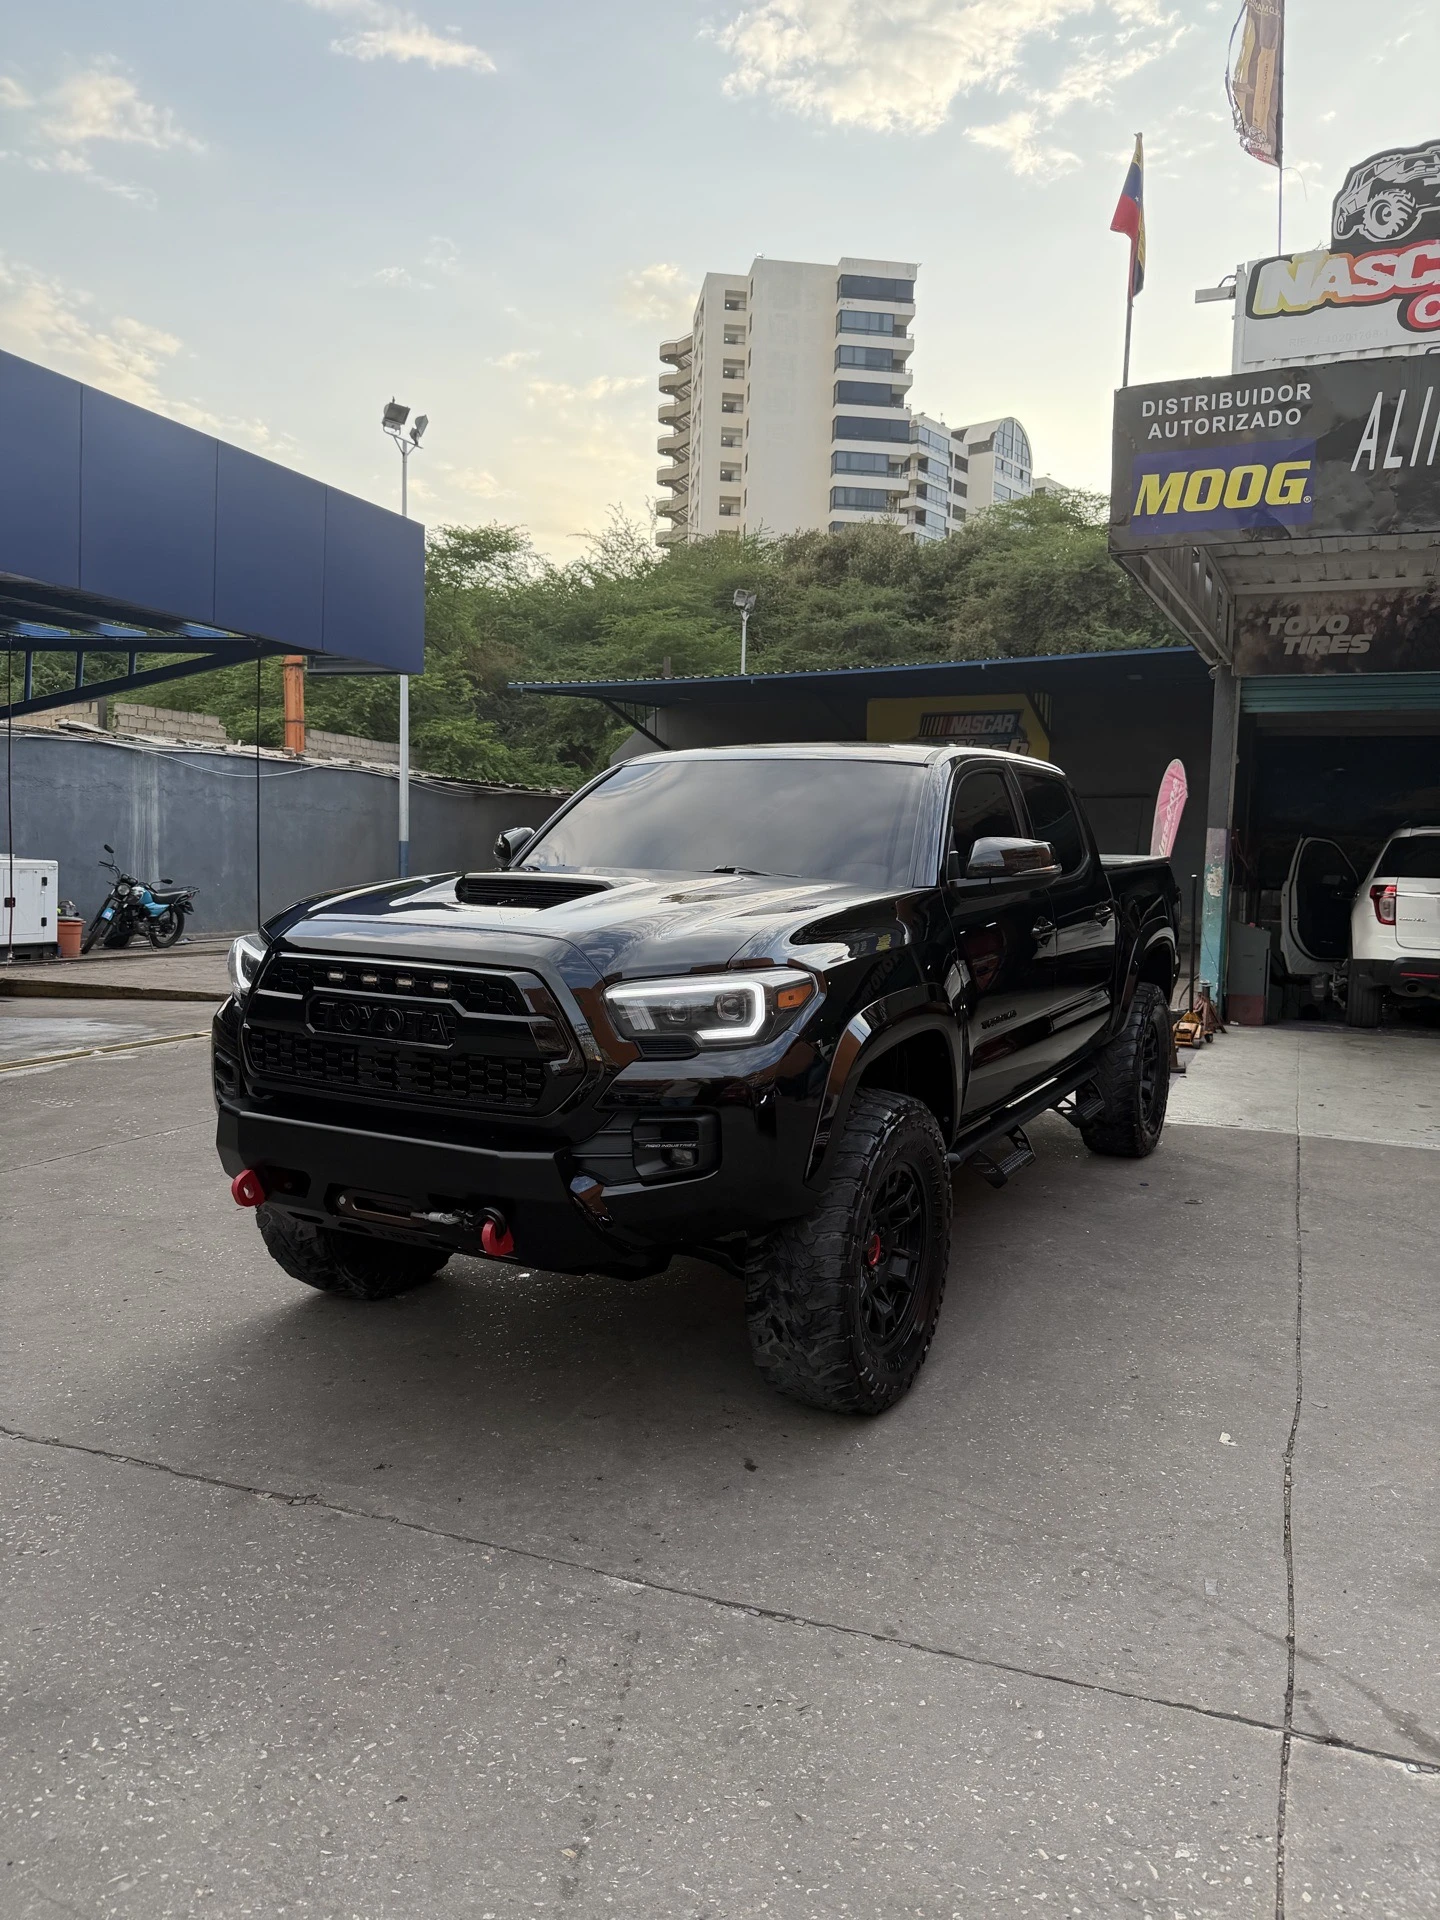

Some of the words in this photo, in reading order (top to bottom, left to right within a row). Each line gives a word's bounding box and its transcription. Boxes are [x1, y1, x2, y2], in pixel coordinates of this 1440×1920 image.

[1253, 242, 1440, 314] NASC
[1141, 383, 1312, 418] DISTRIBUIDOR
[1147, 407, 1302, 440] AUTORIZADO
[1132, 460, 1312, 517] MOOG
[1267, 614, 1350, 637] TOYO
[1282, 634, 1374, 656] TIRES
[949, 713, 1015, 735] NASCAR
[319, 1001, 449, 1041] TOYOTA
